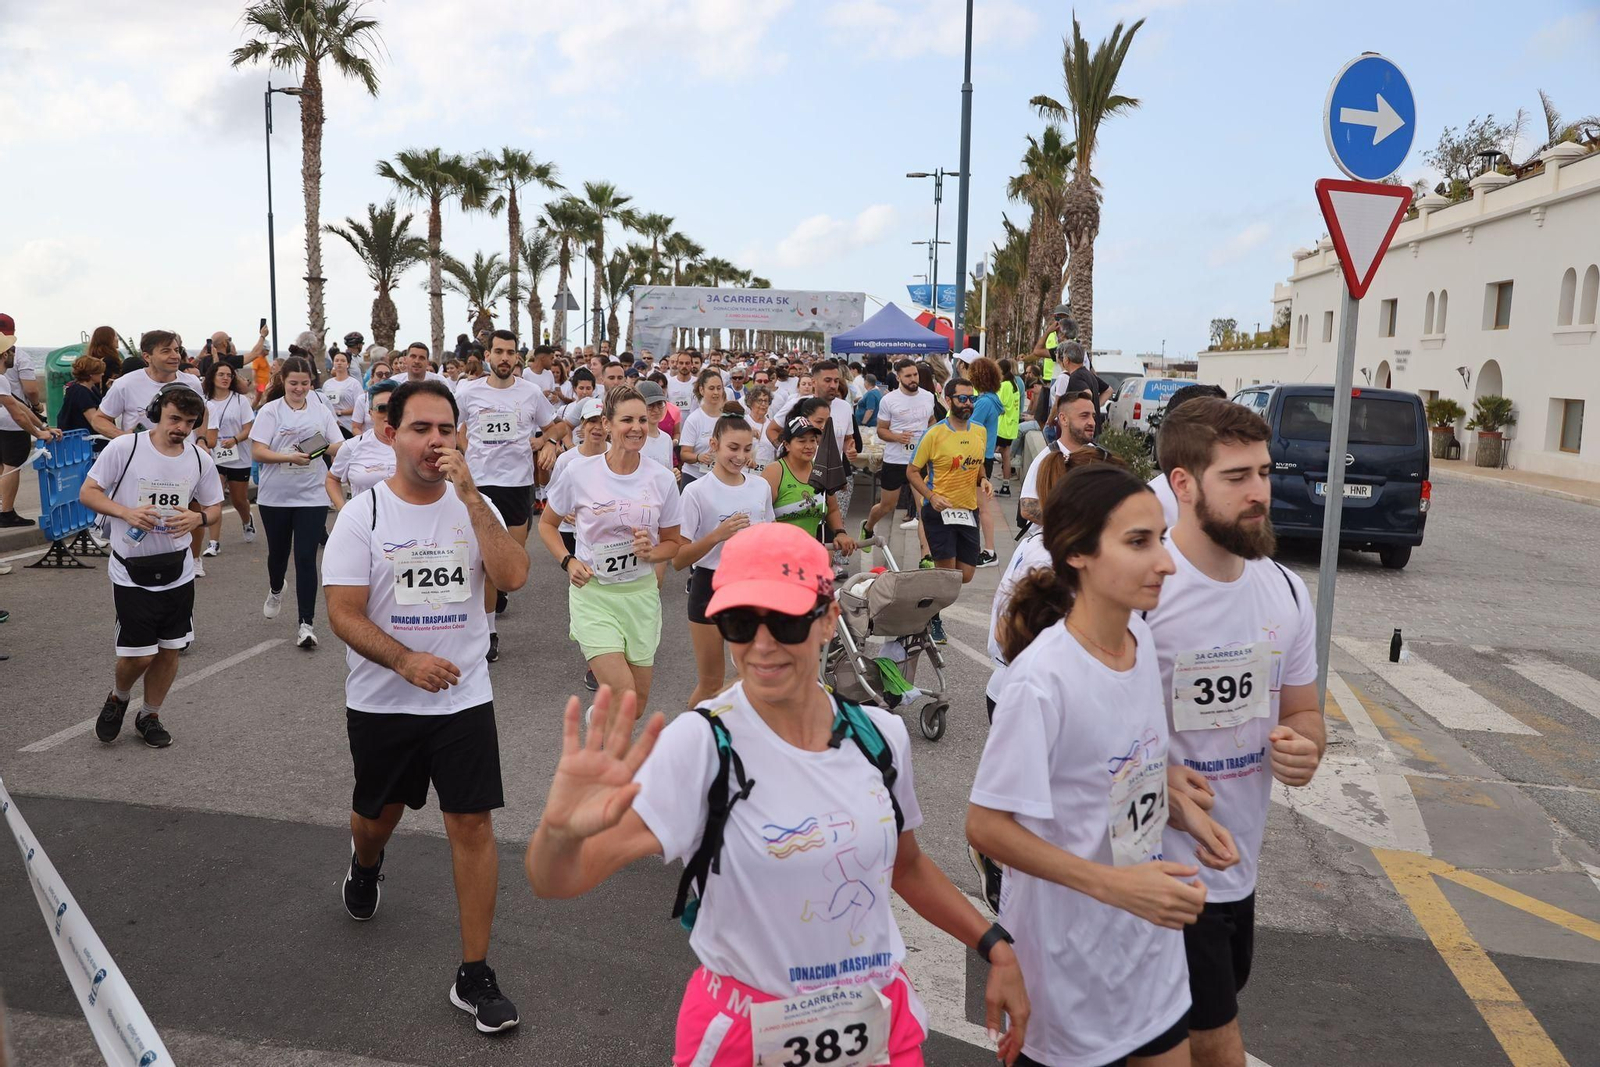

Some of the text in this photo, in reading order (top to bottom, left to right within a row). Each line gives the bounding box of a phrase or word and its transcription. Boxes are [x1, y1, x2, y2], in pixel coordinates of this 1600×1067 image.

[706, 295, 789, 305] 3A CARRERA 5K
[854, 341, 927, 349] info@dorsalchip.es
[487, 422, 511, 433] 213
[216, 449, 233, 459] 243
[1350, 486, 1367, 495] HNR
[149, 493, 180, 506] 188
[945, 511, 969, 520] 1123
[605, 553, 637, 572] 277
[402, 566, 464, 588] 1264
[391, 614, 420, 625] DONACIÓN
[422, 613, 457, 624] TRASPLANTE
[1207, 650, 1243, 659] CARRERA
[1193, 672, 1253, 705] 396
[789, 963, 836, 982] DONACIÓN
[784, 990, 863, 1013] 3A CARRERA 5K
[783, 1022, 869, 1067] 383
